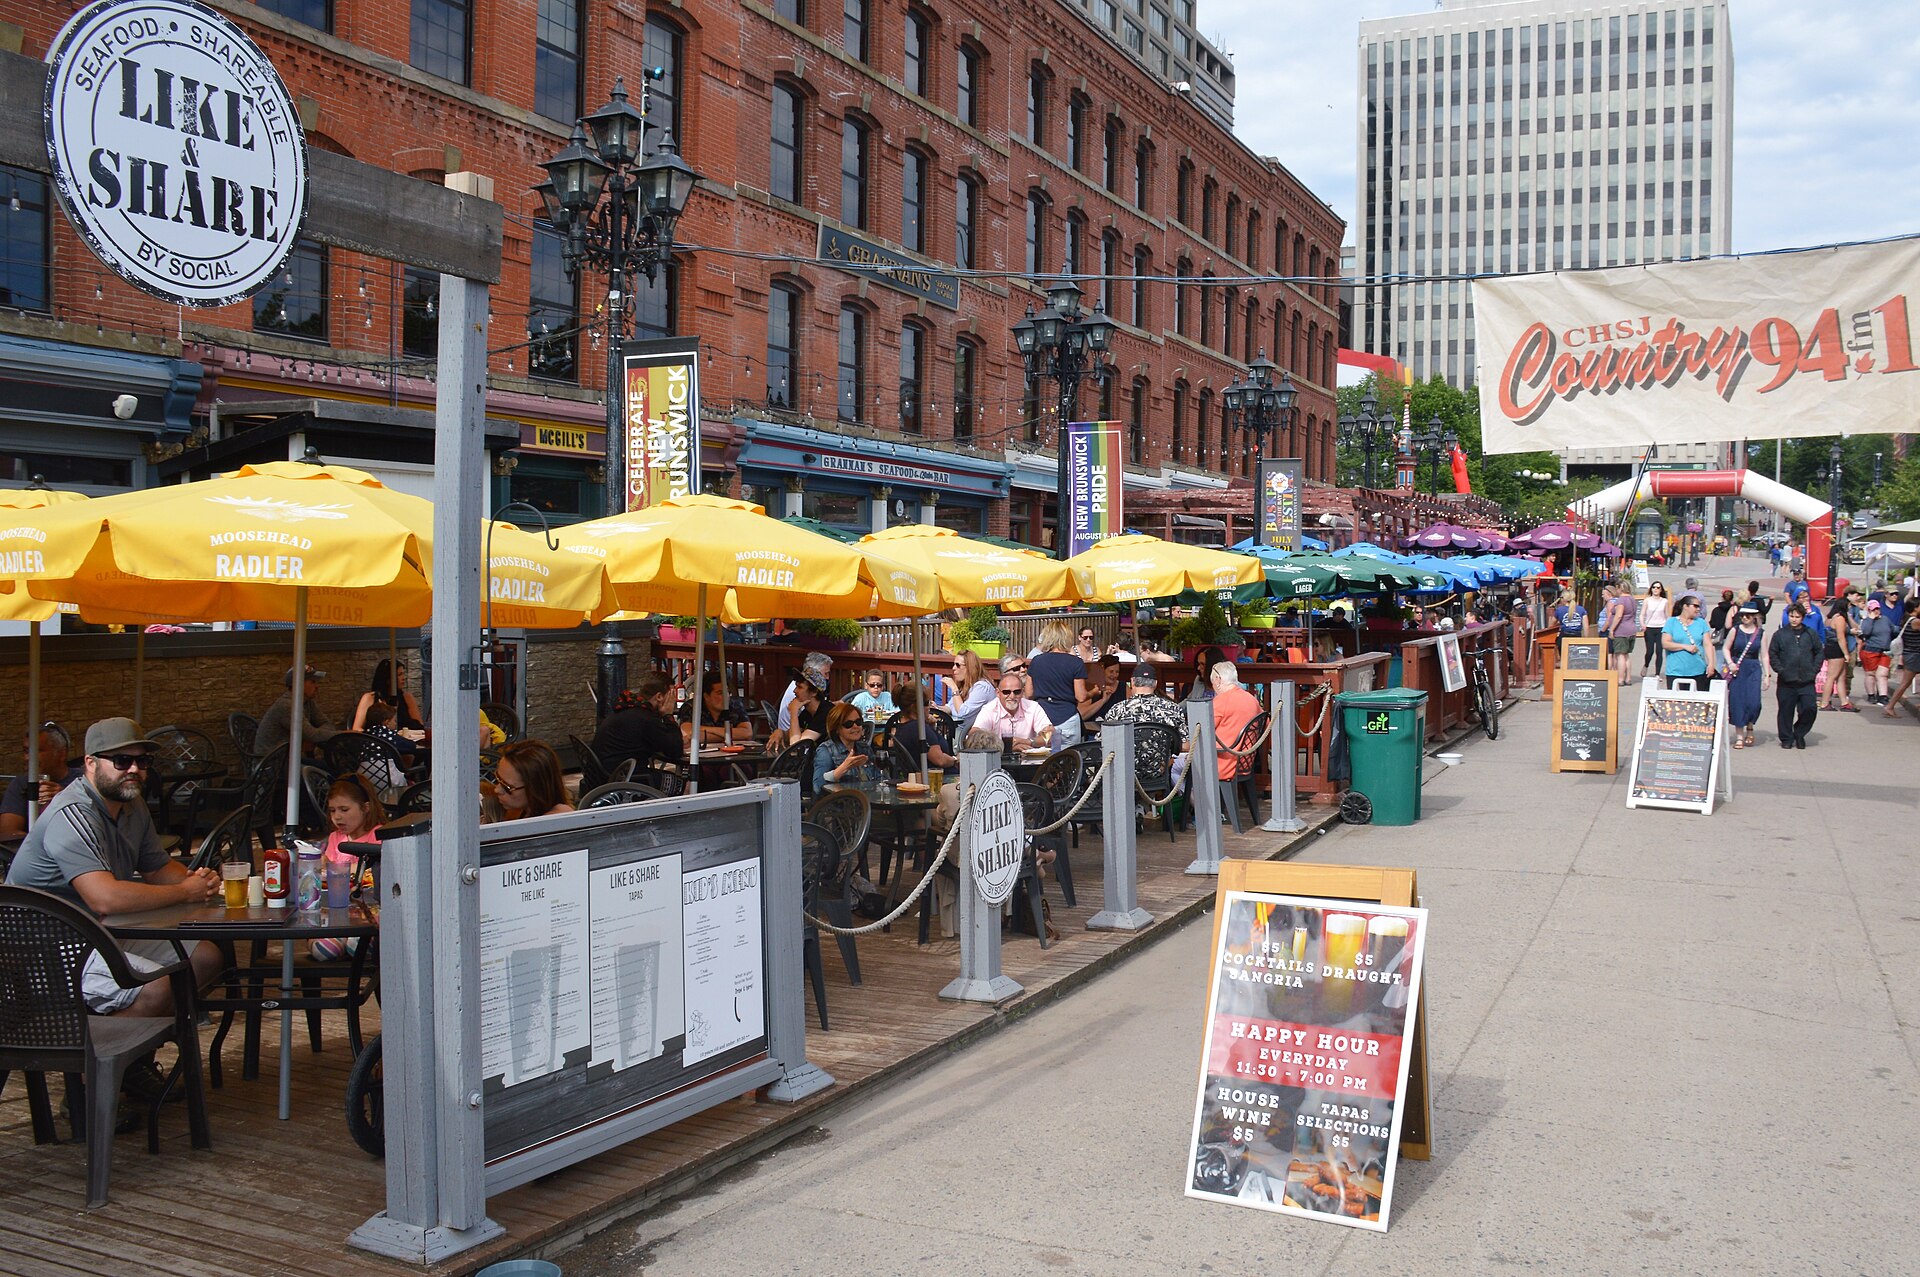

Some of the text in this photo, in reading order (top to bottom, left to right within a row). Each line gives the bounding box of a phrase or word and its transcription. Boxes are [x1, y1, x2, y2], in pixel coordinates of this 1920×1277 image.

[75, 17, 288, 145] SEAFOOD SHAREABLE
[118, 57, 255, 151] LIKE
[181, 137, 200, 168] &
[88, 147, 279, 243] SHARE
[136, 240, 238, 281] BY SOCIAL
[1562, 316, 1651, 347] CHSJ
[1847, 310, 1872, 353] fm
[1499, 318, 1752, 426] Country
[539, 429, 585, 449] MCGILL'S
[630, 391, 644, 495] CELEBRATE
[648, 418, 666, 468] NEW
[668, 365, 688, 500] RUNSWICK
[823, 457, 873, 473] GRANNAN'S
[879, 464, 914, 479] SEAFOOD
[933, 472, 949, 484] BAR
[1075, 436, 1088, 530] NEW BRUNSWICK
[1092, 465, 1107, 513] PRIDE
[0, 527, 47, 543] OOSEHEAD
[209, 530, 313, 550] MOOSEHEAD
[1075, 532, 1102, 540] AUGUST
[1270, 535, 1293, 544] JULY
[216, 554, 304, 579] RADLER
[735, 550, 800, 567] MOOSEHEAD
[737, 566, 794, 588] RADLER
[982, 572, 1028, 584] MOOSEHEAD
[491, 576, 545, 602] RADLER
[986, 585, 1025, 600] RADLER
[1115, 587, 1148, 600] RADLER
[1295, 584, 1313, 594] LAGER
[1368, 719, 1388, 731] GFL
[982, 800, 1012, 835] LIKE
[977, 838, 1019, 878] SHARE
[502, 861, 563, 888] LIKE & SHARE
[610, 864, 660, 889] LIKE & SHARE
[684, 865, 758, 905] KID'S MENU
[521, 888, 545, 902] THE LIKE
[629, 890, 644, 901] TAPAS
[1262, 940, 1280, 953] $5
[1223, 951, 1315, 973] COCKTAILS
[1354, 952, 1374, 966] $5
[1228, 968, 1305, 988] SANGRIA
[1322, 966, 1402, 985] DRAUGHT
[1230, 1022, 1380, 1056] HAPPY HOUR
[1259, 1047, 1349, 1070] EVERYDAY
[1236, 1061, 1277, 1077] 11:30
[1300, 1069, 1335, 1085] 7:00
[1342, 1076, 1367, 1090] PM
[1217, 1087, 1280, 1109] HOUSE
[1221, 1106, 1272, 1126] WINE
[1321, 1103, 1369, 1120] TAPAS
[1232, 1126, 1254, 1142] $5
[1296, 1114, 1389, 1139] SELECTIONS
[1331, 1134, 1350, 1148] $5
